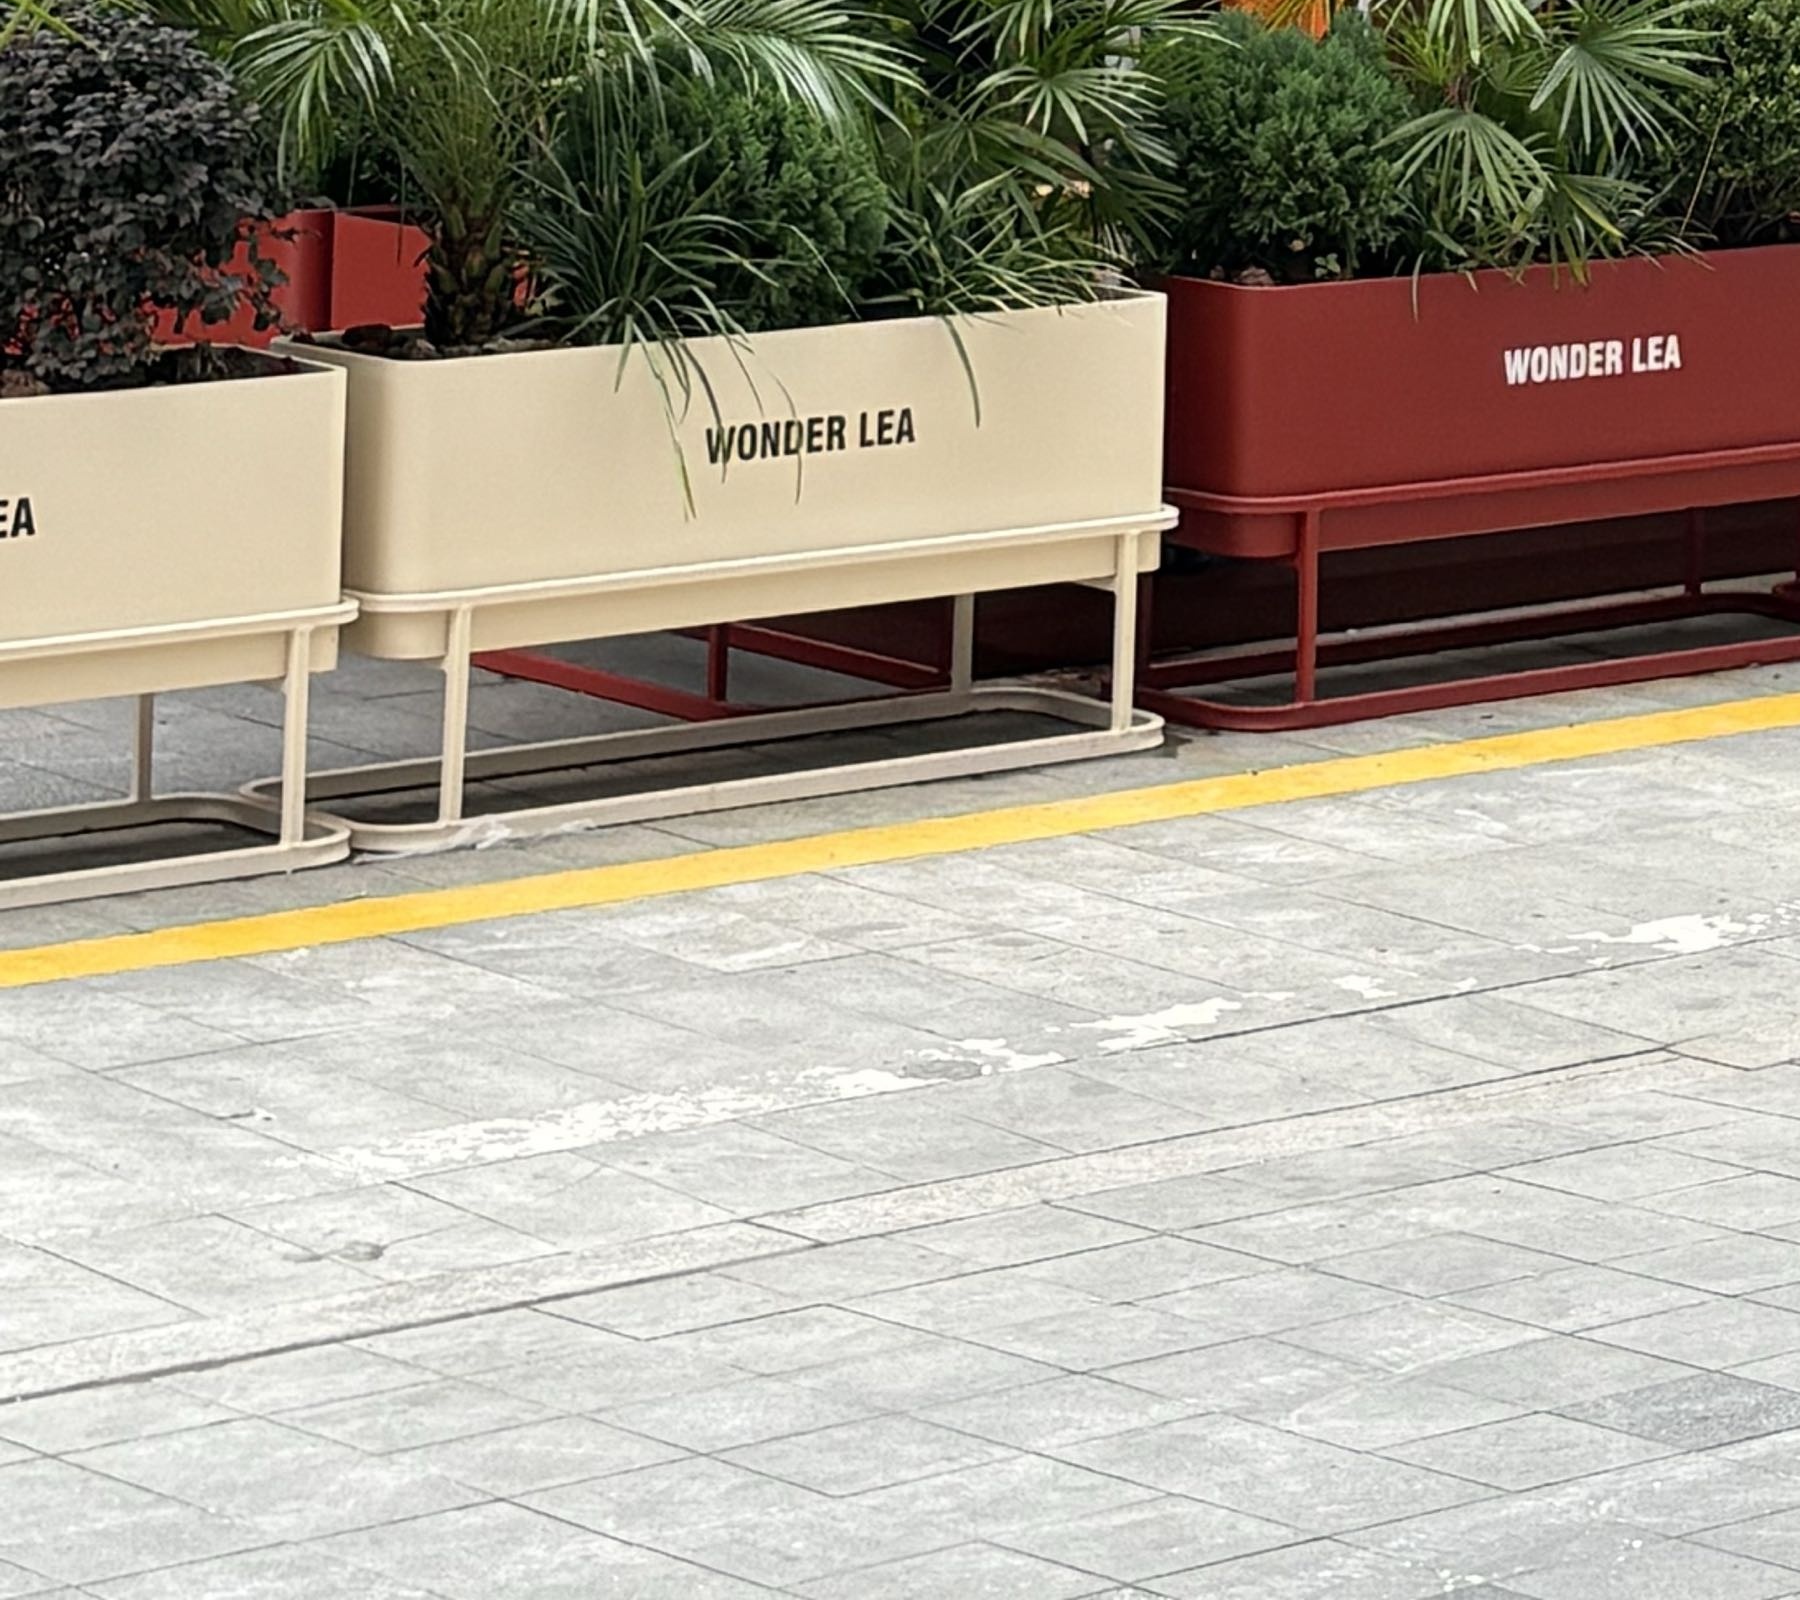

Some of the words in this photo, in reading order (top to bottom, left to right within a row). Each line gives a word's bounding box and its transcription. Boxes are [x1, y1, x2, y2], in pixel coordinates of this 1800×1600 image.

[1504, 340, 1623, 385] WONDER
[1632, 335, 1681, 372] LEA
[706, 416, 846, 464] WONDER
[860, 408, 915, 447] LEA
